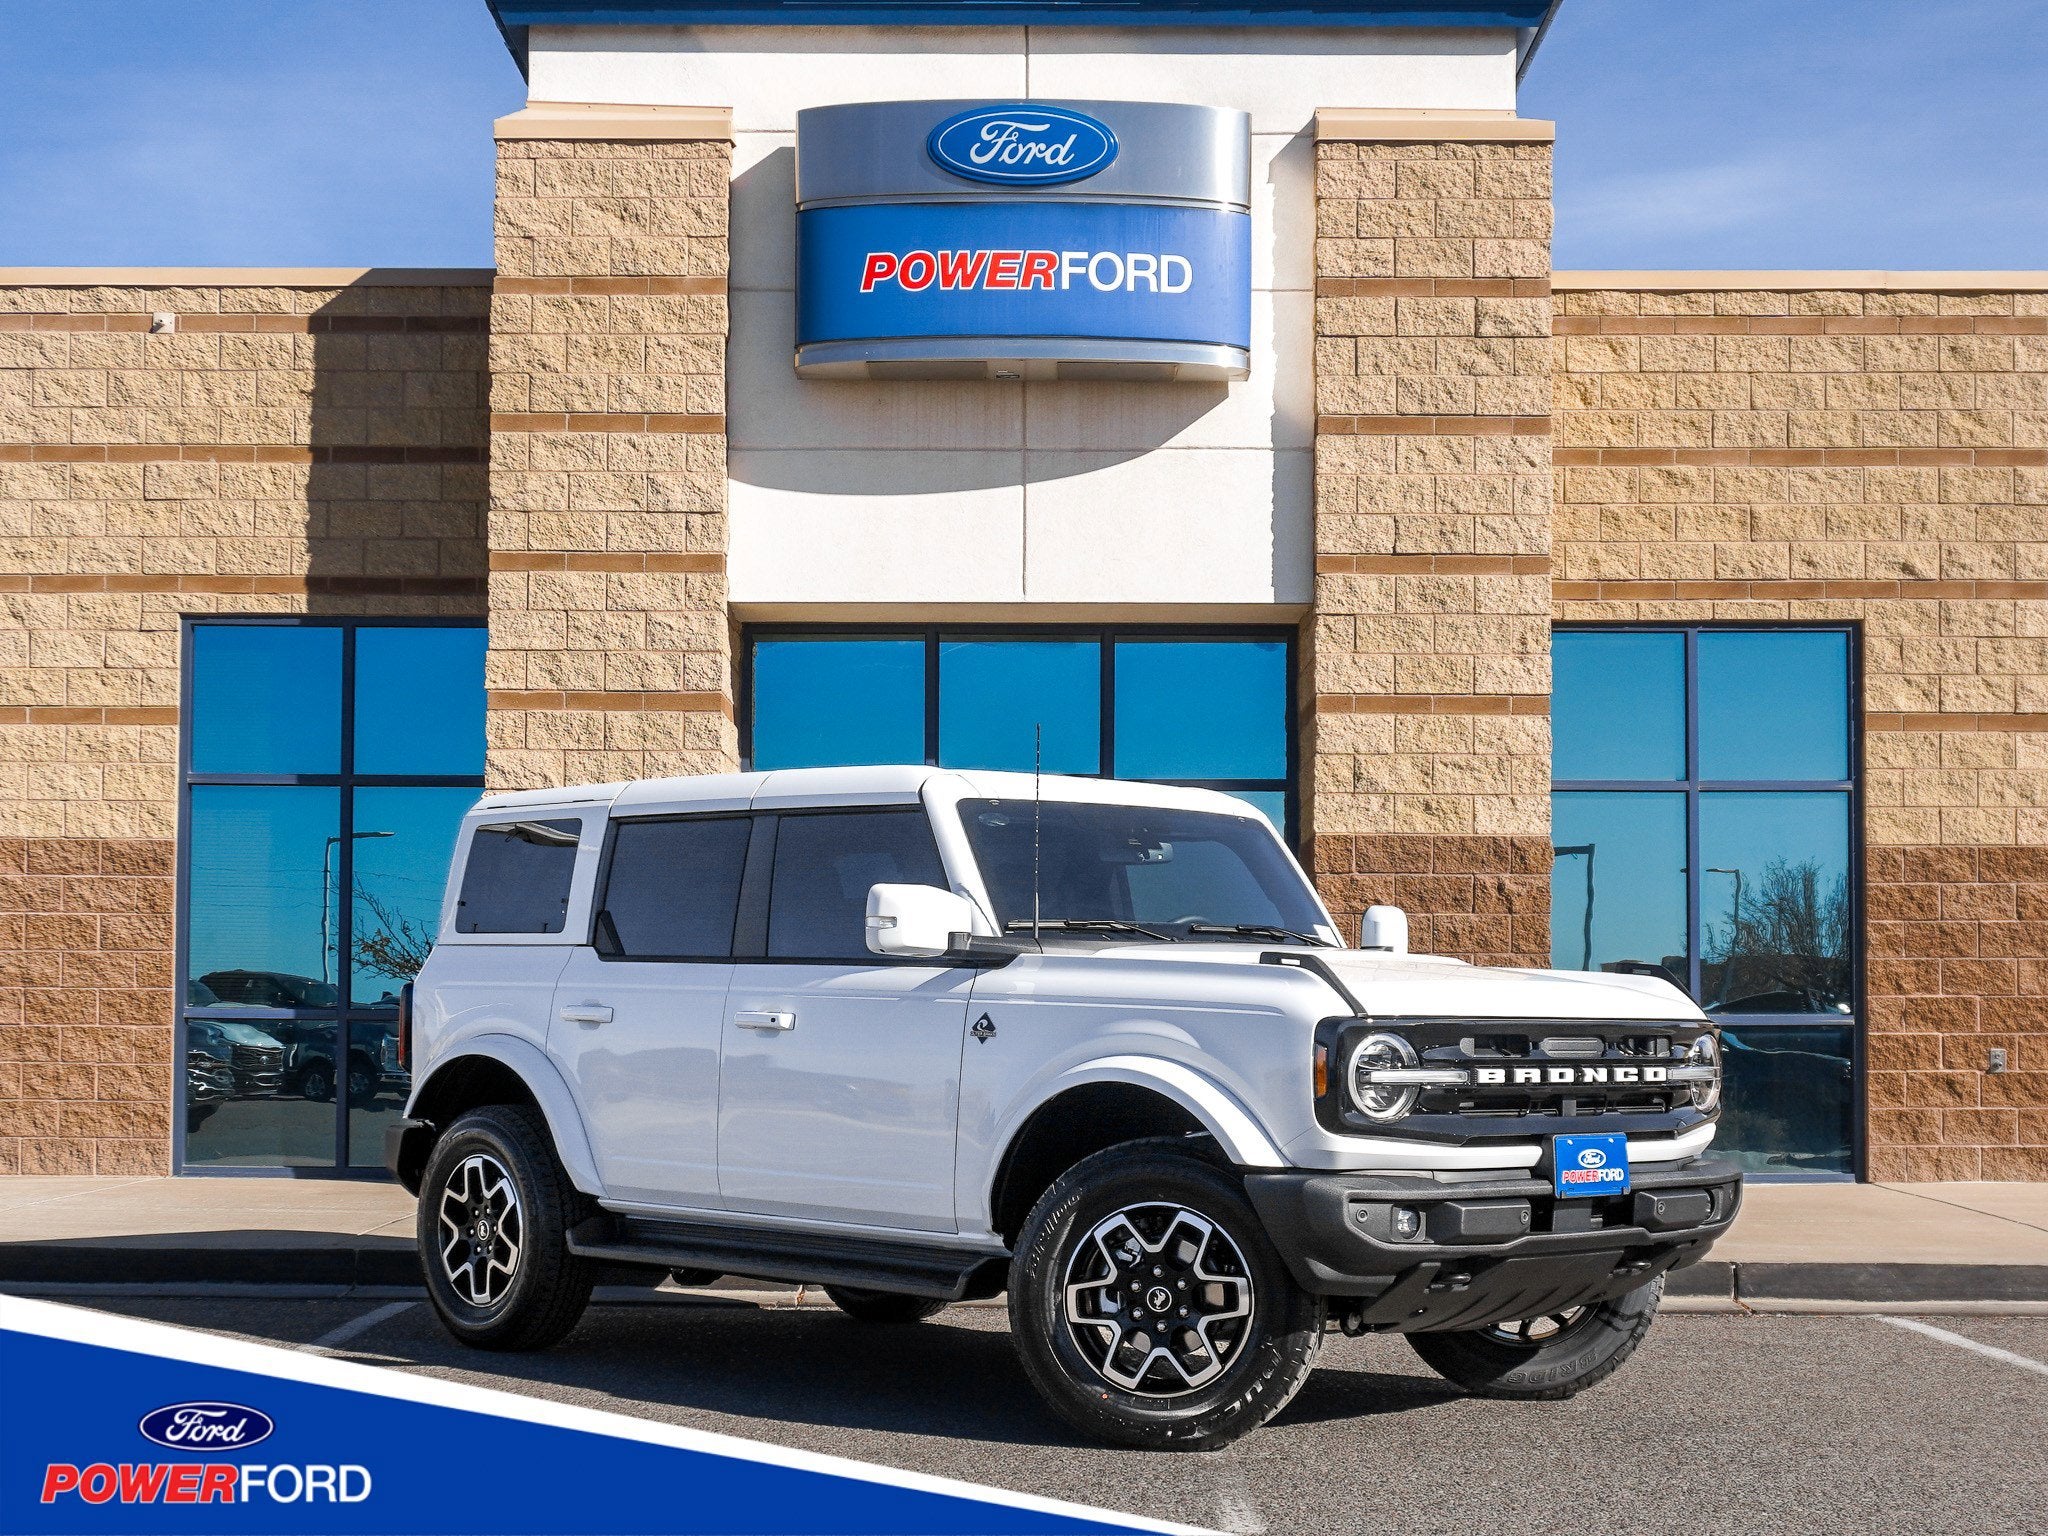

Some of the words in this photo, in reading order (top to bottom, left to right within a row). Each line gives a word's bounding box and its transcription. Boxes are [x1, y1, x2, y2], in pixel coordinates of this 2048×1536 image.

[970, 121, 1076, 166] Ford
[1477, 1067, 1668, 1084] BRONCO
[1583, 1152, 1601, 1164] Ford
